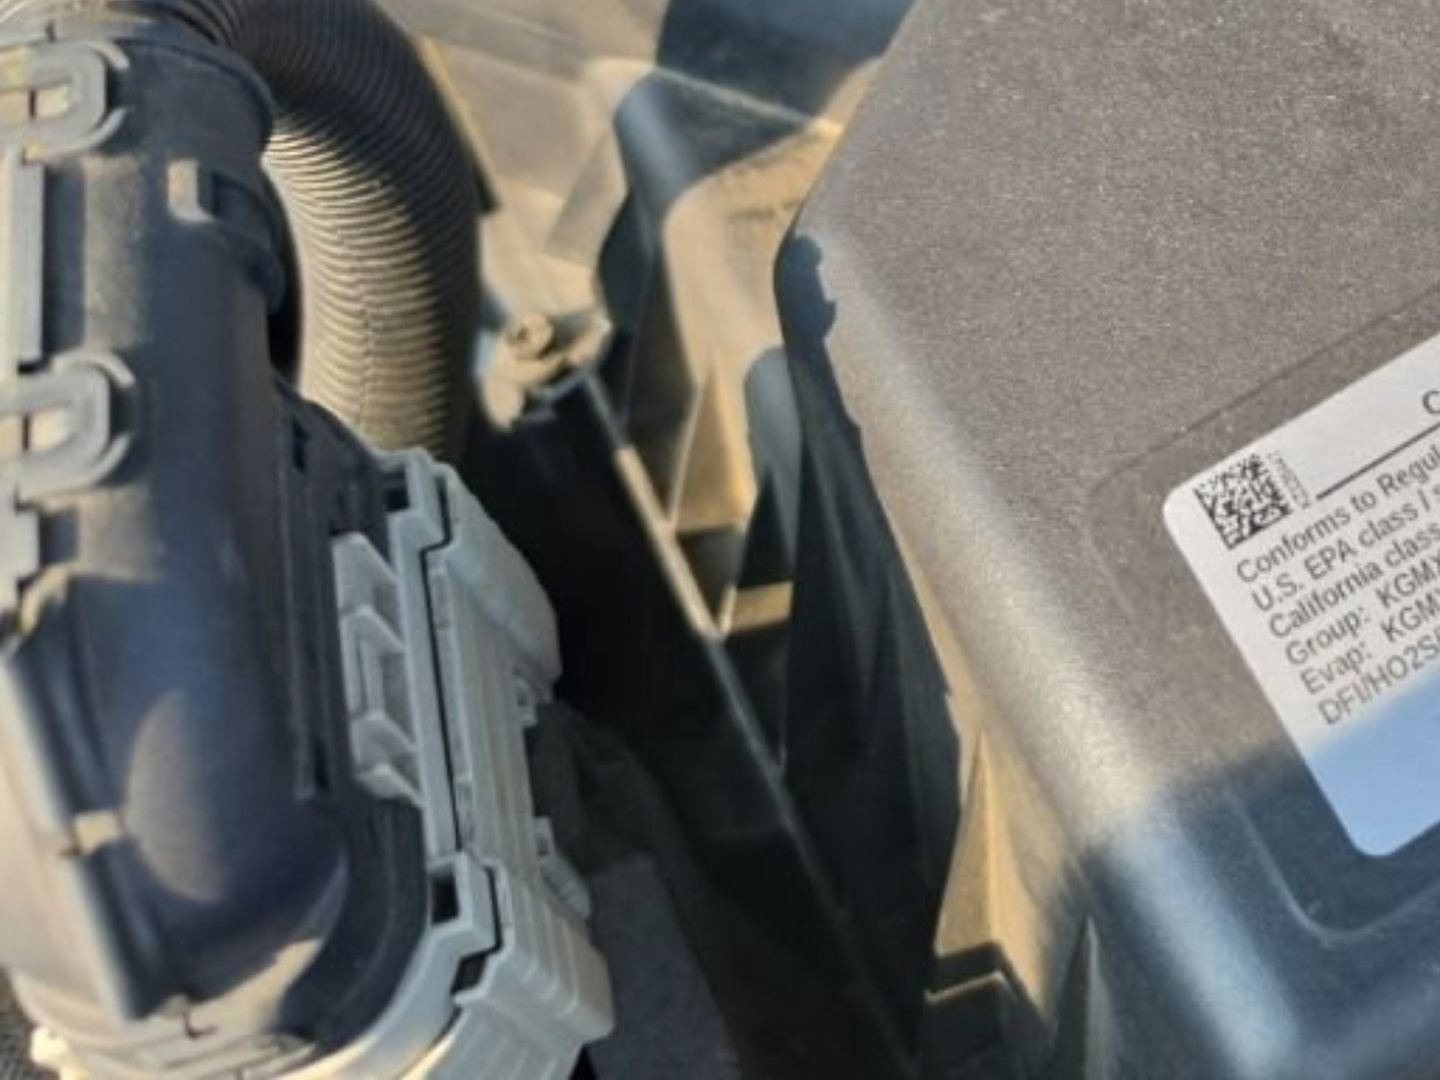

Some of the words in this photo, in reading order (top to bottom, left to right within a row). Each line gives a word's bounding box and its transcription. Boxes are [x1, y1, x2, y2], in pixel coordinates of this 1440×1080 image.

[1236, 507, 1351, 584] Conforms
[1349, 491, 1377, 515] to
[1250, 572, 1306, 612] U.S.
[1303, 538, 1358, 581] EPA
[1357, 502, 1419, 548] class
[1268, 561, 1385, 639] California
[1284, 606, 1371, 666] Group:
[1299, 641, 1373, 695] Evap:
